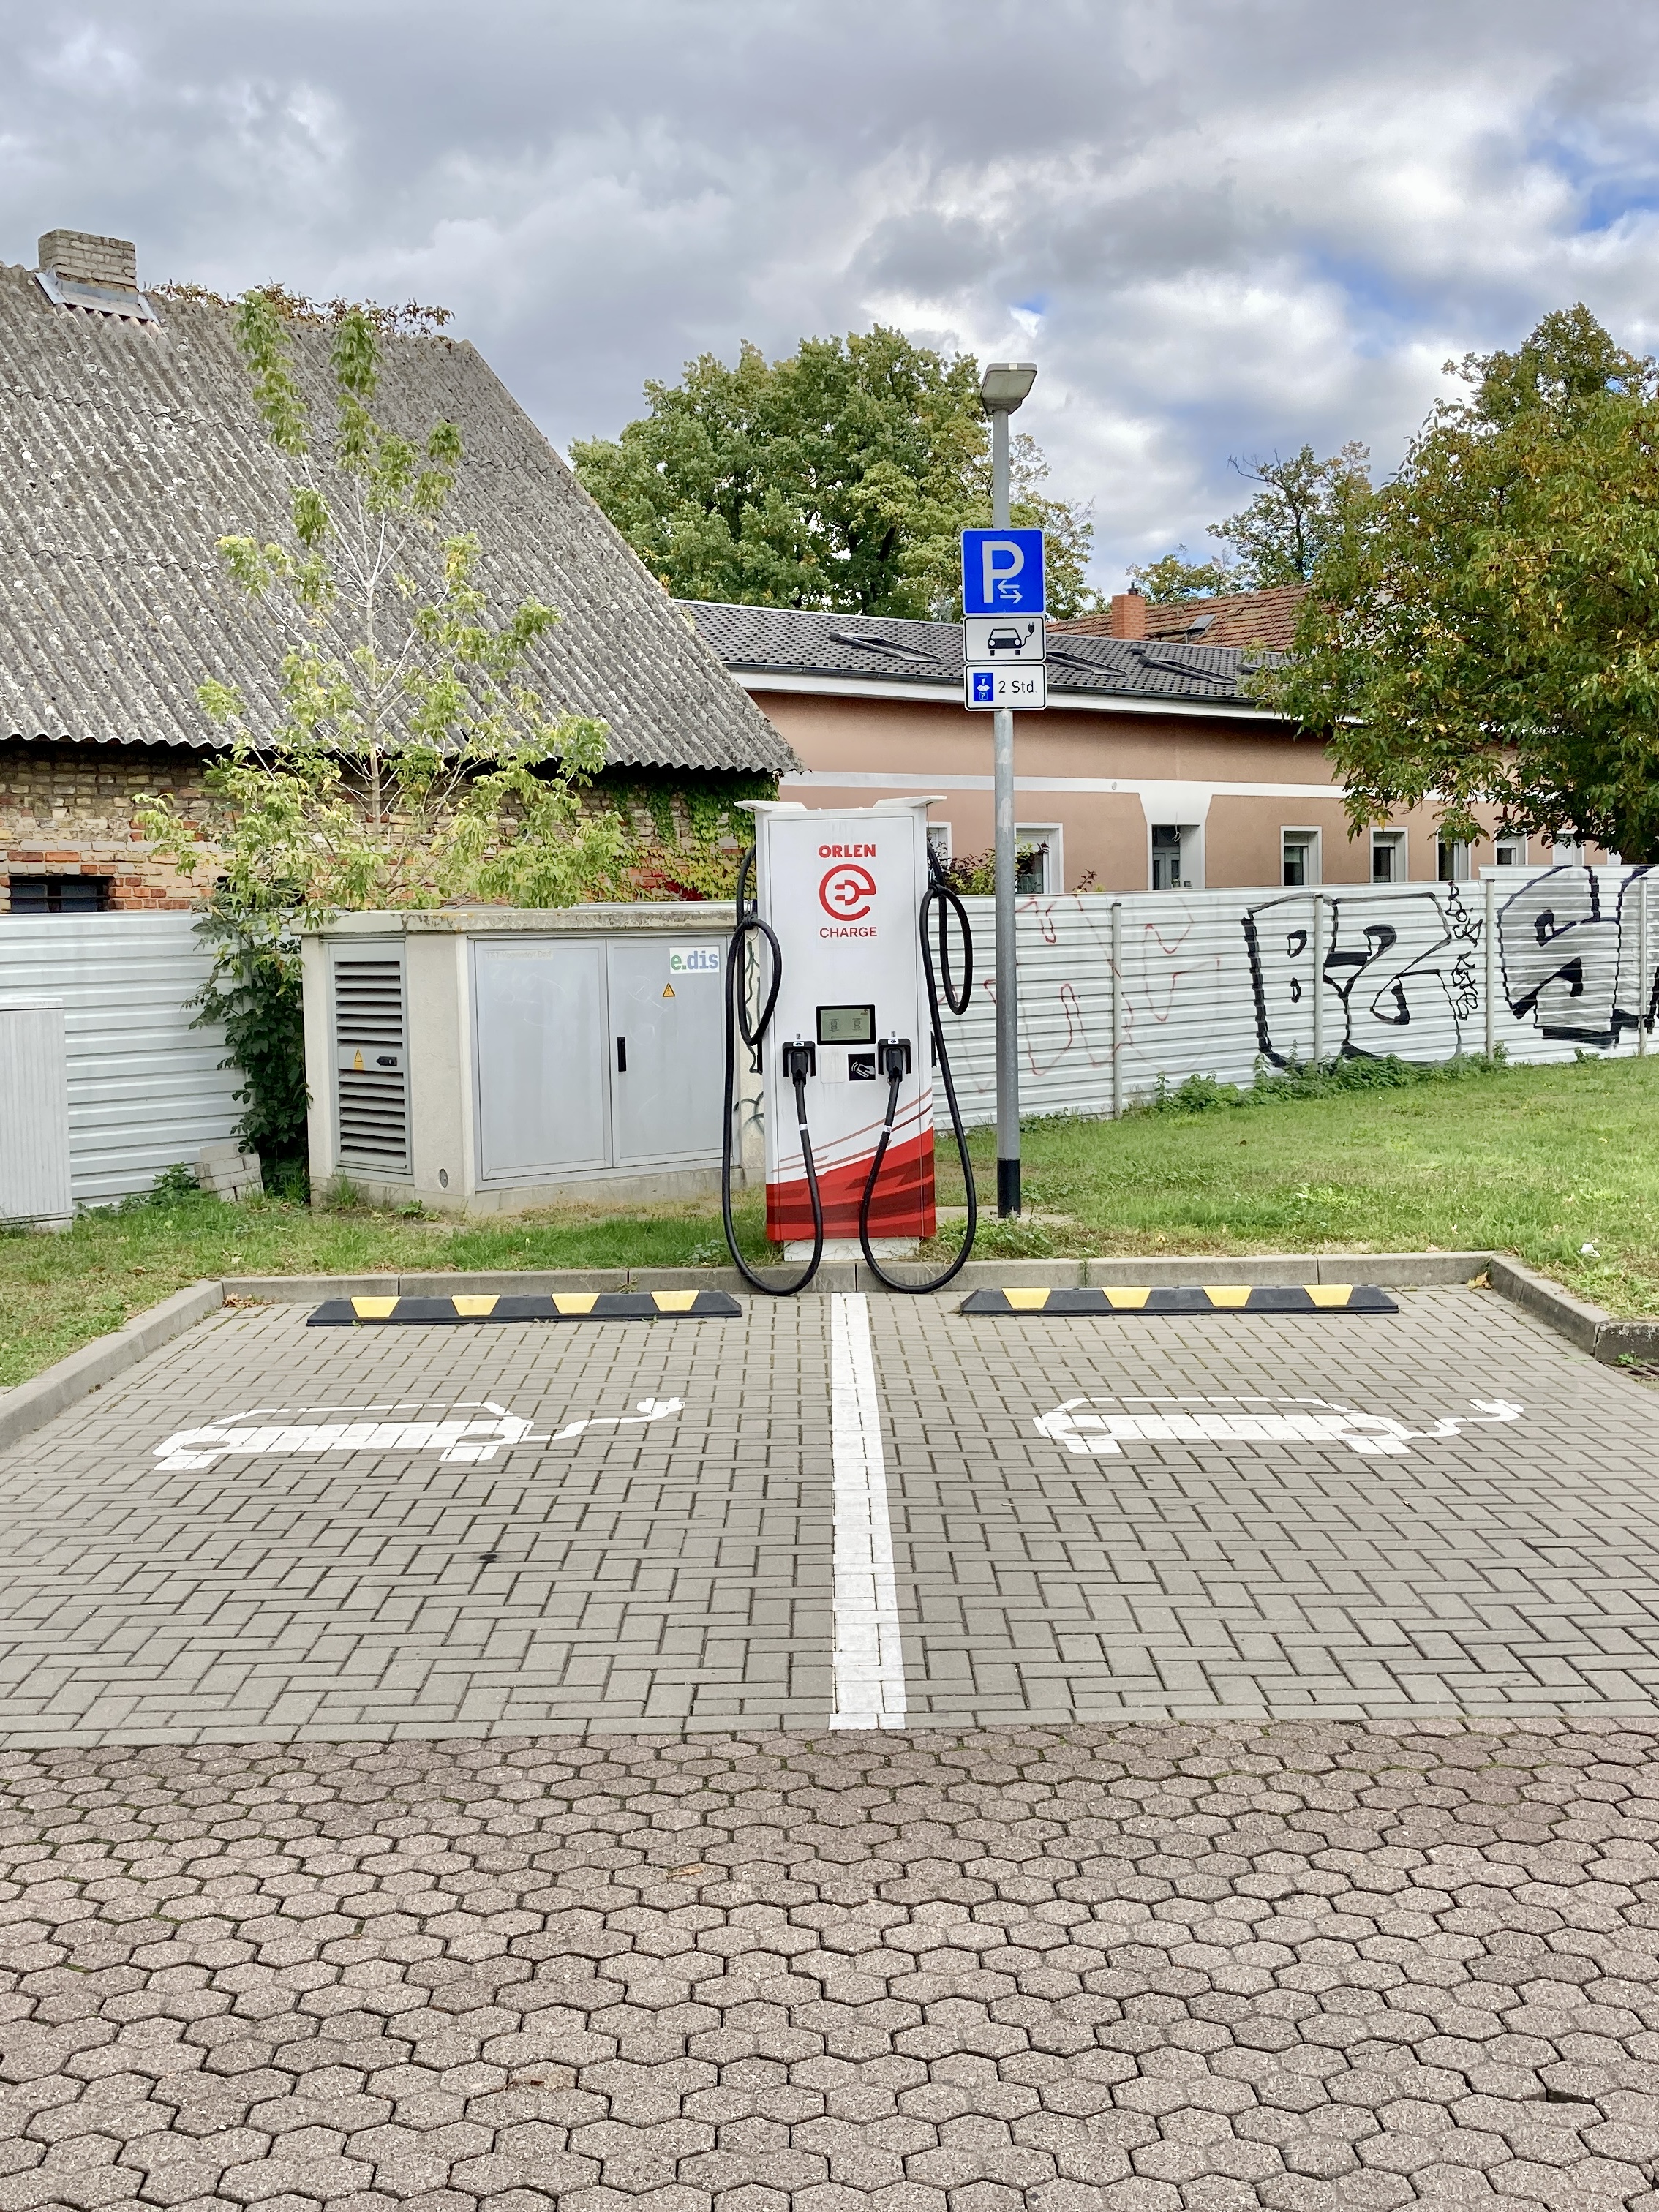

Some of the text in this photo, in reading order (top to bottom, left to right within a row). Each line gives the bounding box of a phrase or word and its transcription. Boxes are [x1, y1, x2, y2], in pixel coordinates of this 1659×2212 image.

[982, 540, 1024, 603] P
[998, 680, 1038, 693] 2 Std.
[819, 844, 876, 858] ORLEN
[819, 926, 877, 938] CHARGE
[671, 950, 718, 971] e.dis
